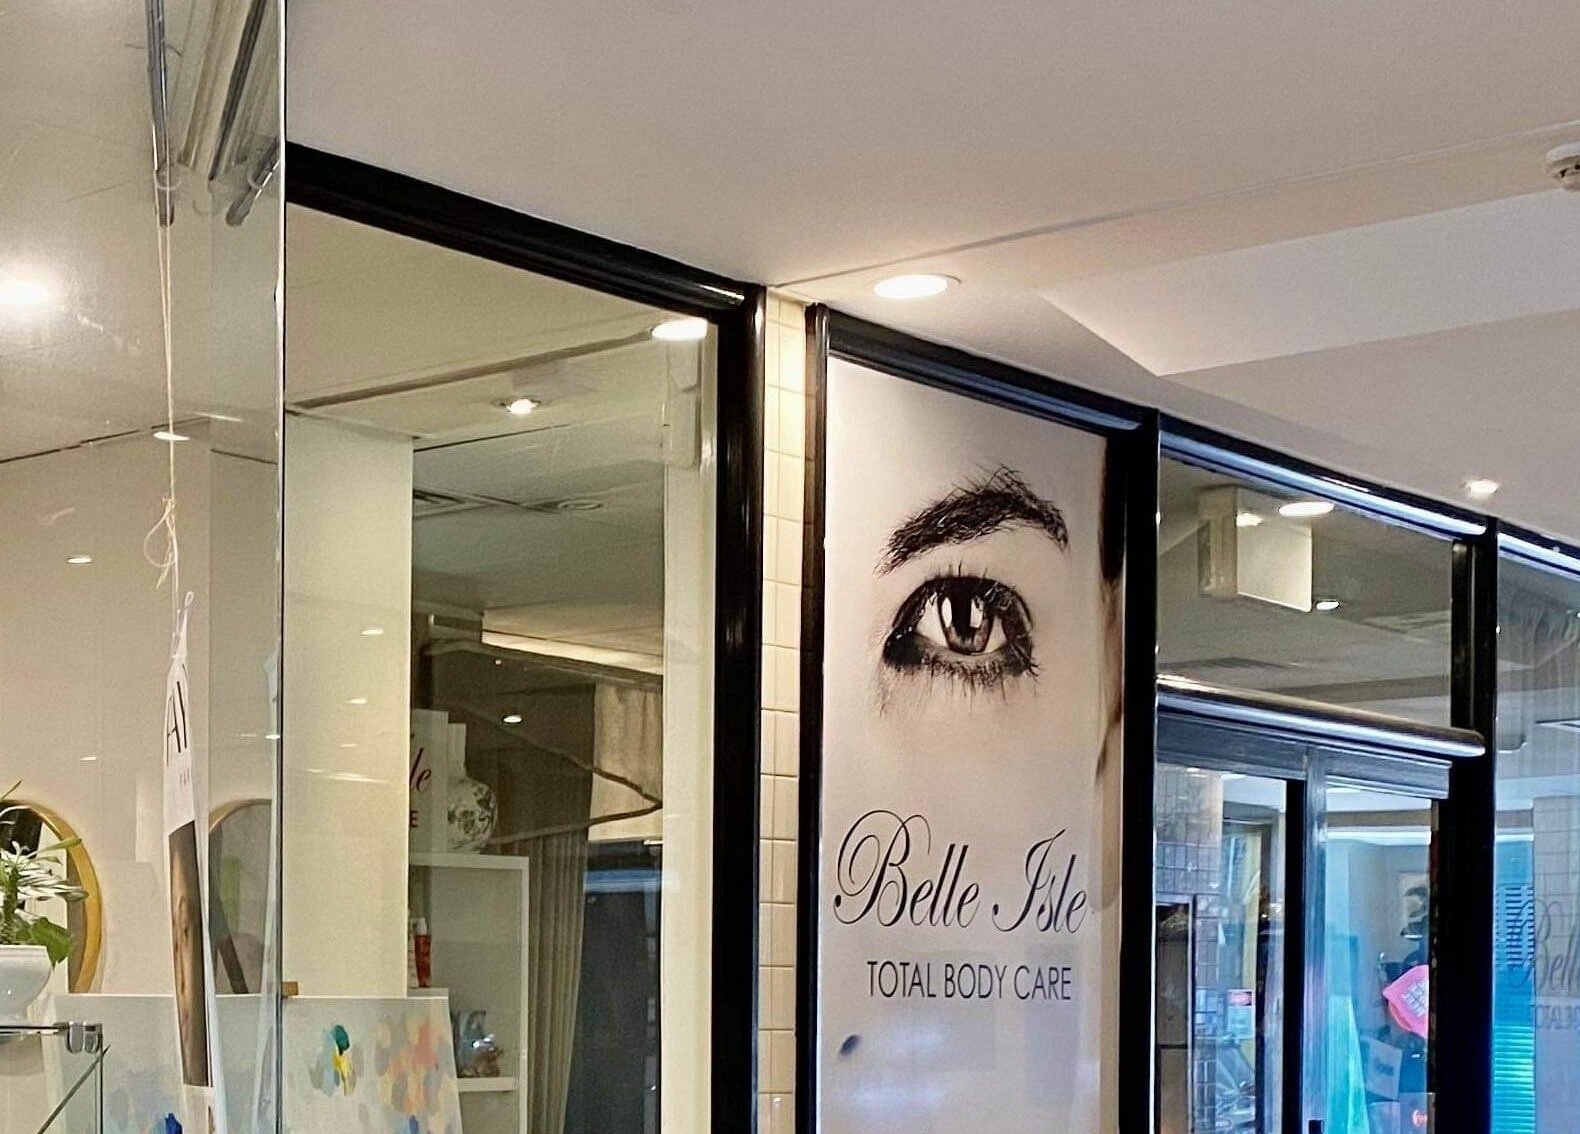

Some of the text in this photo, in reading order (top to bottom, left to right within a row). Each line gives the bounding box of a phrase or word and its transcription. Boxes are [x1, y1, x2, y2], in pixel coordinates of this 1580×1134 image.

[833, 810, 1087, 934] Belle Isle
[867, 960, 1072, 1001] TOTAL BODY CARE
